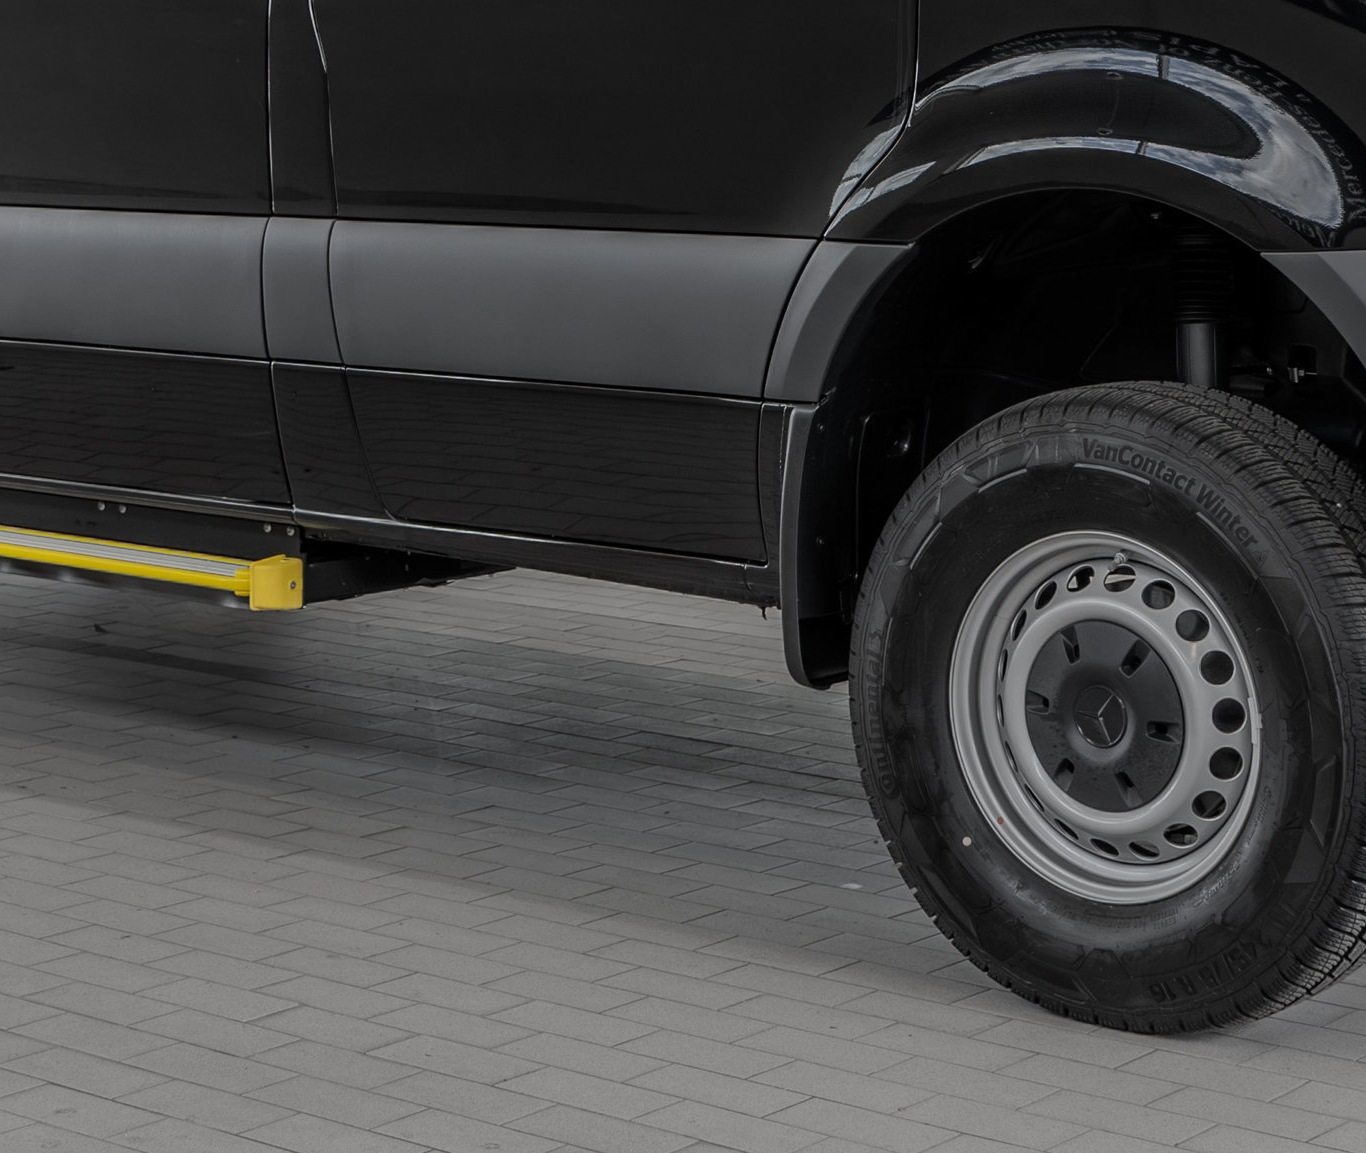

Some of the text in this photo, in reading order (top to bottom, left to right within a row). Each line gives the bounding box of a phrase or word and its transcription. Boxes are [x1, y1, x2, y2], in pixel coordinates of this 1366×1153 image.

[1082, 437, 1259, 548] VanContact Winter
[866, 647, 898, 799] Continental
